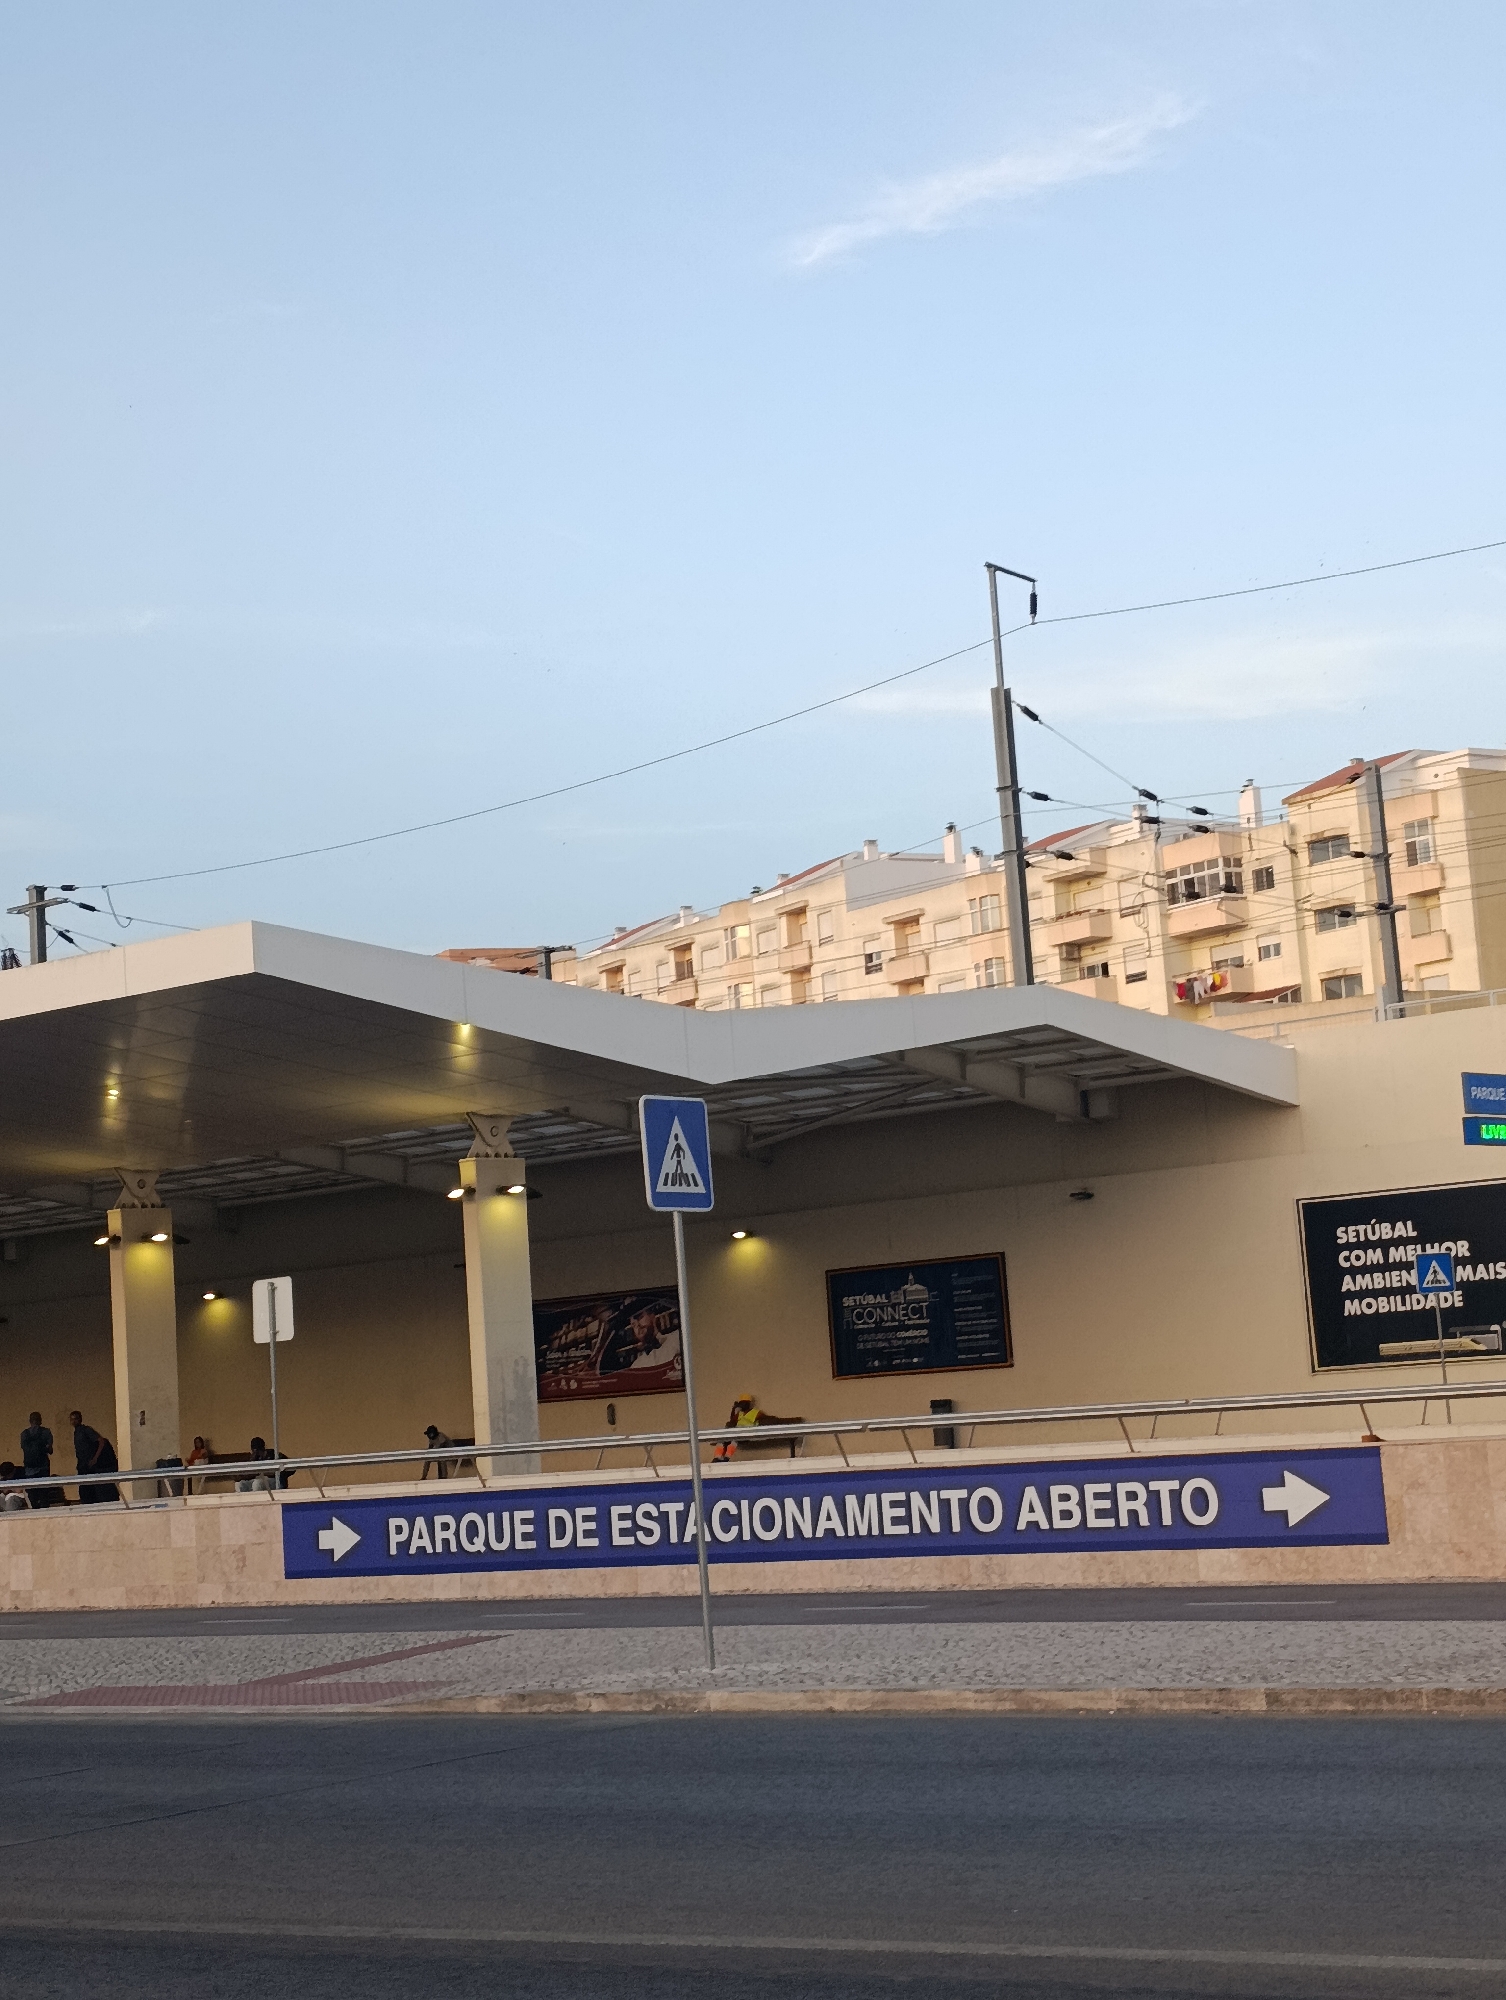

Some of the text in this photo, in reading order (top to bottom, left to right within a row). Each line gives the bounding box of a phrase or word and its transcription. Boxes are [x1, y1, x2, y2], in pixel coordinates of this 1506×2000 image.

[1470, 1086, 1506, 1100] PARQUE
[1336, 1219, 1418, 1244] SETÚBAL
[1338, 1247, 1384, 1268] COM
[1341, 1261, 1506, 1292] AMBIEN MAIS
[842, 1292, 889, 1307] SETÚBAL
[1344, 1290, 1464, 1317] MOBILIDADE
[852, 1302, 930, 1324] CONNECT
[388, 1477, 1219, 1555] PARQUE DE ESTACIONAMENTO ABERTO
